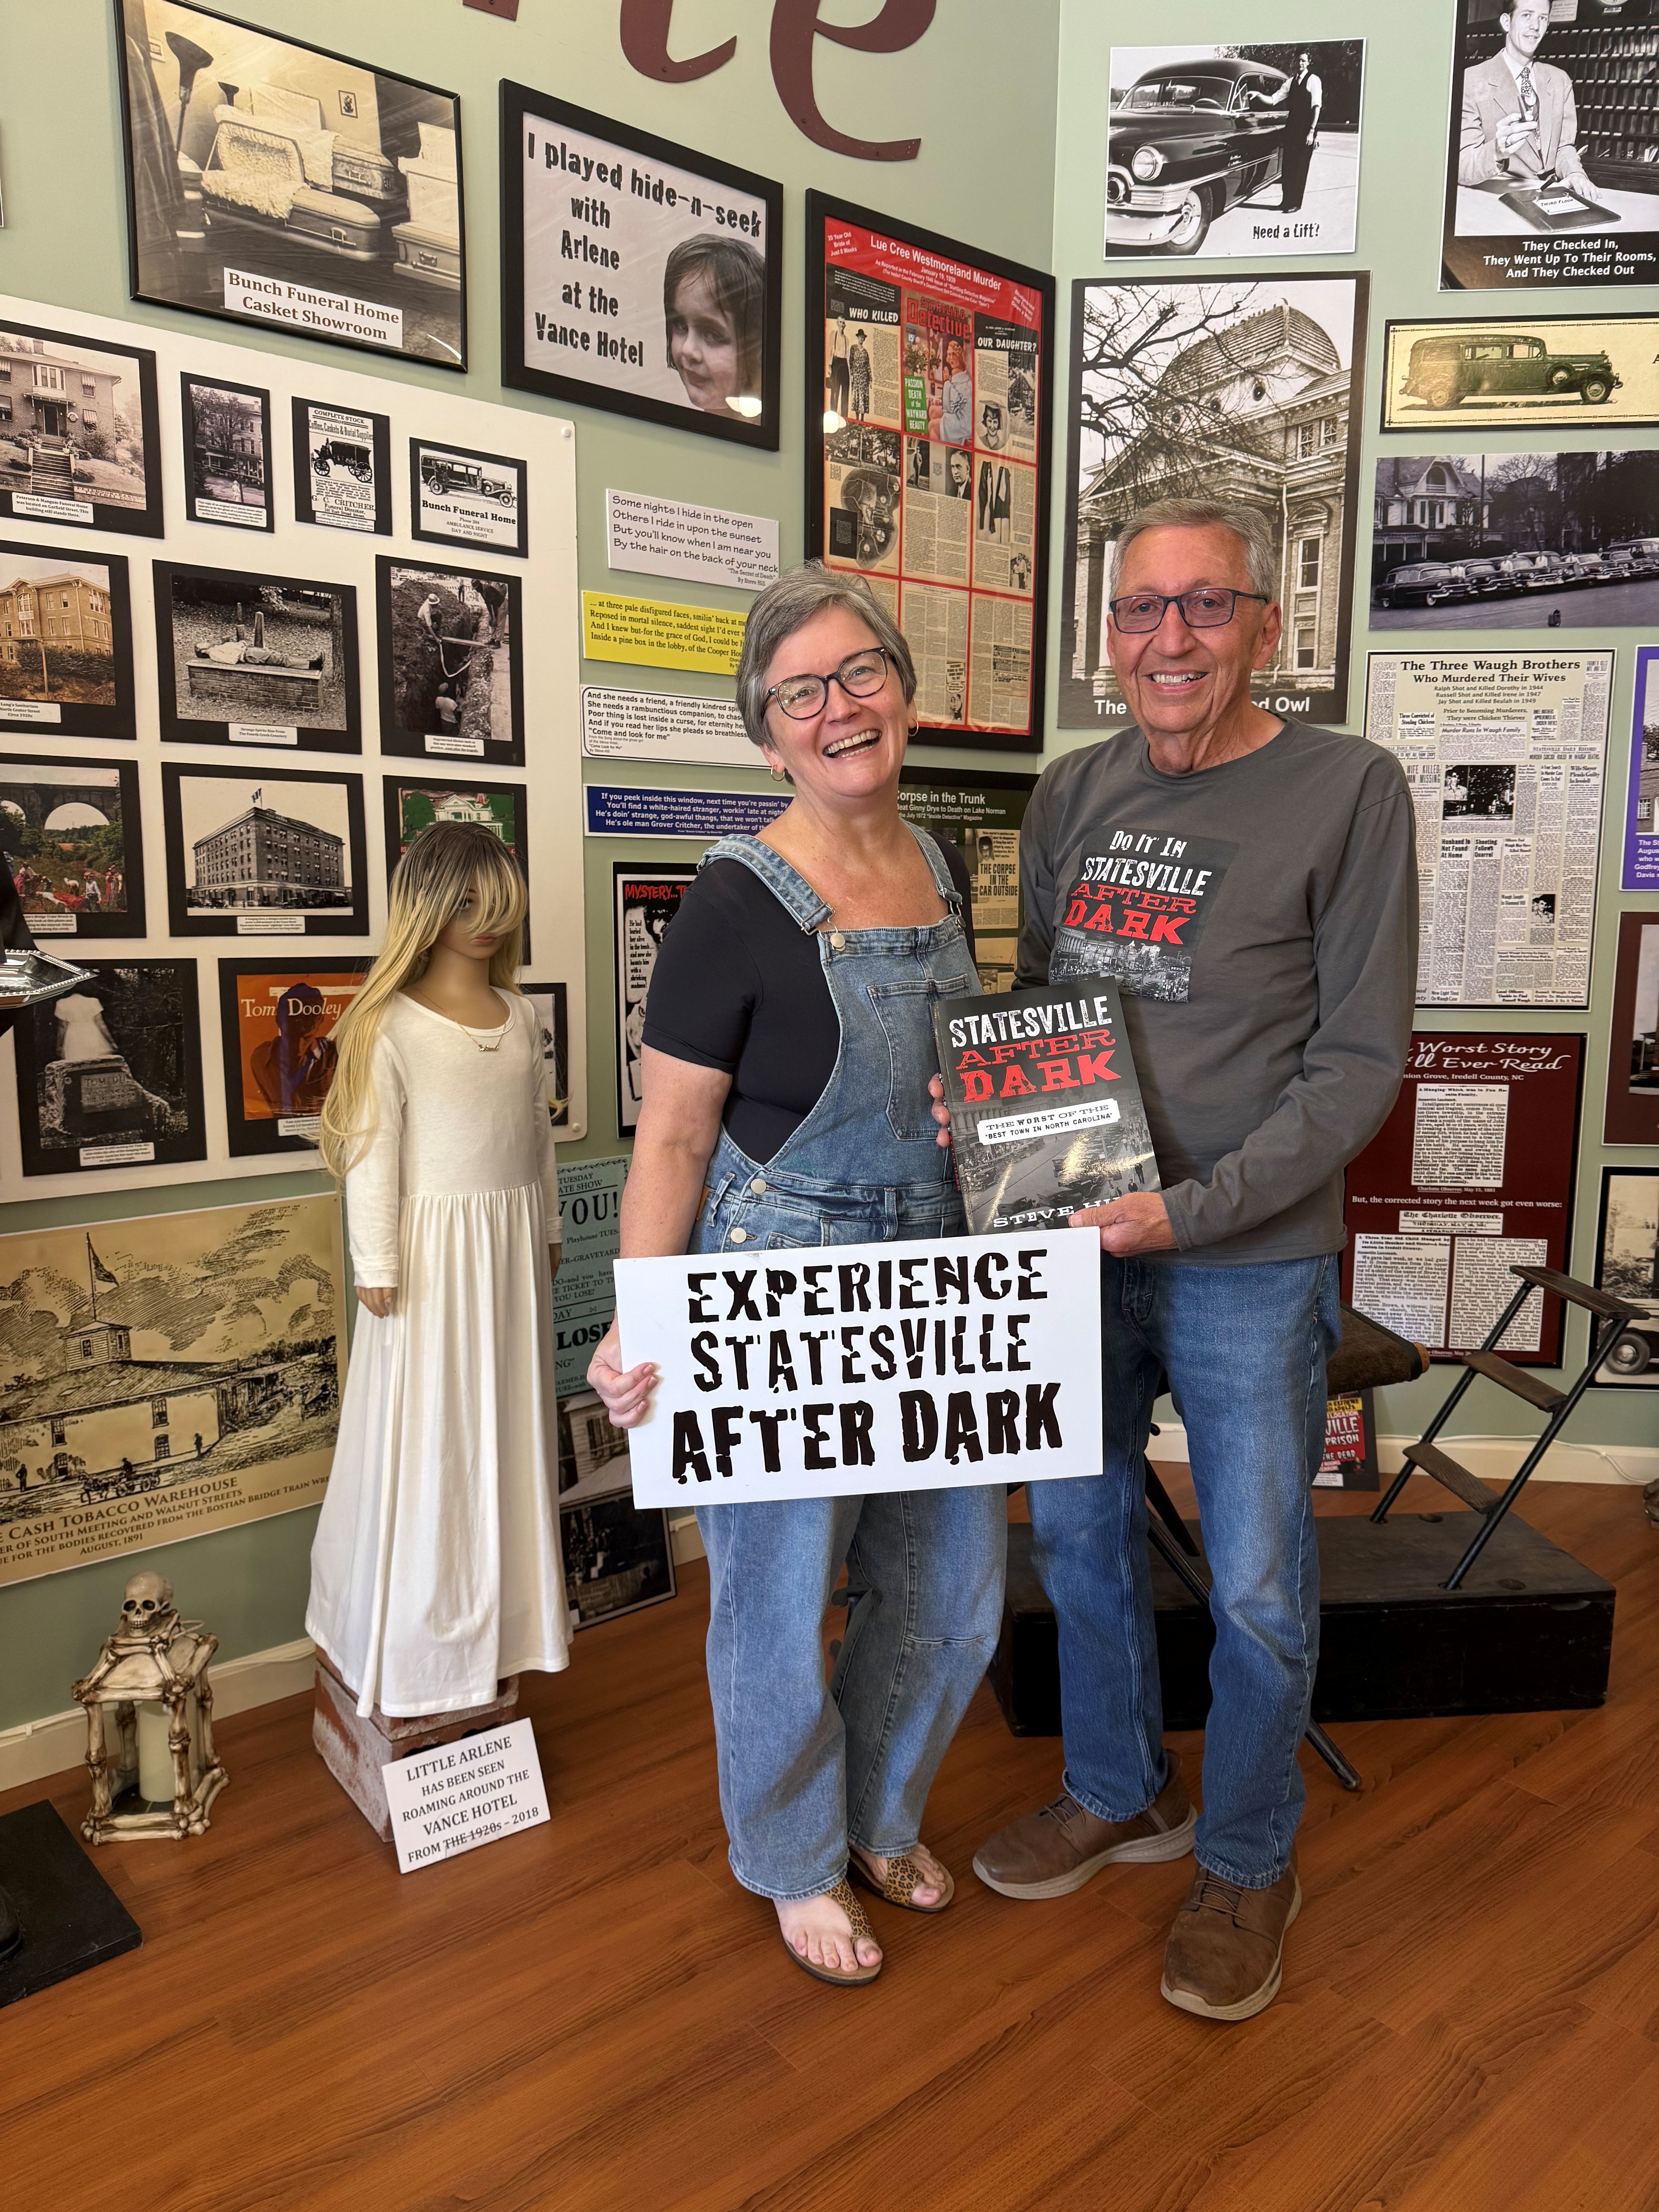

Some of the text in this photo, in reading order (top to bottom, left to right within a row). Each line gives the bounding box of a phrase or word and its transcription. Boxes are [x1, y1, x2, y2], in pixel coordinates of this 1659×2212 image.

[528, 132, 762, 237] I played hide-n-seek
[571, 196, 611, 229] with
[1252, 223, 1320, 239] Need a Lift?
[561, 229, 619, 271] Arlene
[1522, 239, 1619, 253] They Checked In,
[871, 235, 887, 252] Lue
[890, 242, 910, 259] Cree
[912, 249, 971, 281] Westmoreland
[973, 271, 1002, 291] Murder
[1483, 252, 1656, 267] They Went Up To Their Rooms,
[1506, 265, 1635, 279] And They Checked Out
[228, 272, 399, 324] Bunch Funeral Home
[562, 282, 619, 317] at the
[243, 297, 387, 340] Casket Showroom
[849, 307, 898, 323] WHO KILLED
[535, 312, 644, 367] Vance Hotel
[977, 337, 1037, 352] OUR DAUGHTER?
[905, 378, 923, 388] PASSION
[908, 389, 922, 400] DEATH
[314, 409, 364, 424] COMPLETE STOCK
[906, 409, 927, 419] WAYWARD
[909, 420, 925, 430] BEAUTY
[422, 500, 516, 524] Bunch Funeral Home
[613, 496, 753, 529] Some nights I hide in the open
[606, 601, 623, 610] three
[625, 604, 638, 612] pale
[640, 605, 672, 617] disfigured
[673, 610, 692, 620] faces,
[693, 614, 714, 622] smilin'
[715, 616, 730, 624] back
[1400, 660, 1581, 673] The Three Waugh Brothers
[1413, 673, 1566, 683] Who Murdered Their Wives
[1094, 697, 1310, 714] The Owl
[624, 794, 641, 803] peek
[678, 797, 704, 805] window,
[931, 791, 985, 804] in the Trunk
[1109, 830, 1133, 851] DO
[1160, 837, 1188, 859] IN
[980, 863, 1016, 875] THE CORPSE
[989, 874, 1009, 885] IN THE
[1081, 856, 1212, 896] STATESVILLE
[979, 885, 1018, 896] CAR OUTSIDE
[1070, 883, 1197, 914] AFTER
[1064, 899, 1191, 945] DARK
[241, 998, 342, 1020] Tom Dooley
[948, 995, 1112, 1048] STATESVILLE
[955, 1029, 1116, 1070] AFTER
[1417, 1041, 1552, 1061] Worst Story
[1443, 1055, 1571, 1073] Ever Read
[959, 1049, 1121, 1103] DARK
[986, 1105, 1109, 1131] THE WORST OF THE
[1010, 1127, 1030, 1136] TOWN
[1045, 1121, 1070, 1130] NORTH
[558, 1173, 594, 1184] TUESDAY
[993, 1205, 1075, 1228] STEVE
[687, 1249, 1048, 1324] EXPERIENCE
[691, 1314, 1032, 1393] STATESVILLE
[672, 1382, 1062, 1485] AFTER DARK
[9, 1476, 238, 1540] CASH TOBACCO WAREHOUSE
[80, 1533, 143, 1555] AUGUST, 1891
[406, 1736, 512, 1781] LITTLE ARLENE
[422, 1760, 505, 1797] HAS BEEN SEEN
[402, 1769, 530, 1822] ROAMING AROUND THE
[423, 1794, 518, 1836] VANCE HOTEL
[408, 1843, 441, 1863] FROM
[443, 1833, 467, 1849] THE
[468, 1821, 502, 1841] 1920s
[512, 1806, 539, 1825] 2018
